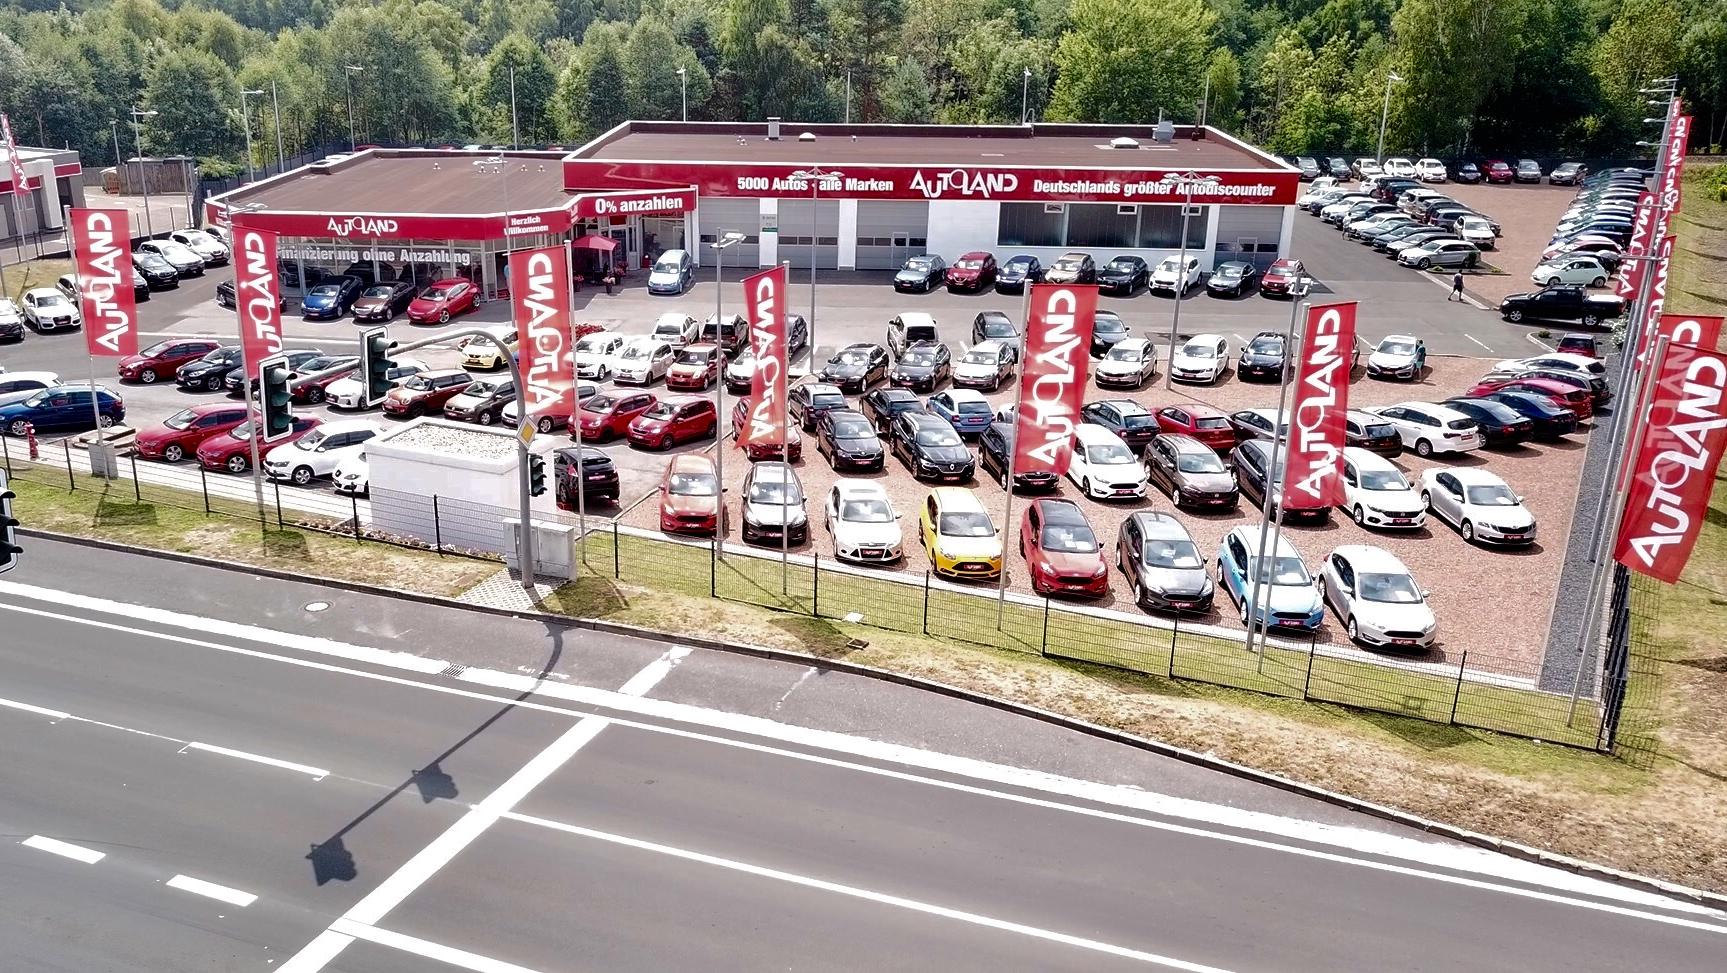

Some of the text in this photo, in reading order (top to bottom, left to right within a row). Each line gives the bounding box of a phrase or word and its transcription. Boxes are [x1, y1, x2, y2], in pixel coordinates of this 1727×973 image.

[737, 177, 769, 191] 5000
[772, 176, 808, 191] Autos
[845, 177, 894, 192] Marken
[909, 168, 1019, 198] AUTOLAND
[1033, 179, 1276, 197] Deutschlands größter Autodiscounter
[595, 196, 683, 214] 0% anzahlen
[327, 216, 398, 237] AUTOLAND
[503, 224, 549, 236] Willkommen
[511, 215, 541, 226] Herzlich
[362, 246, 395, 262] ohne
[400, 248, 471, 266] Anzahlung
[87, 212, 129, 352] AUTOLAND
[244, 231, 283, 363] UTOLAND
[1027, 288, 1082, 466] AUTOLAND
[1294, 308, 1344, 500] AUTOLAND
[1628, 355, 1727, 568] AUTOLAND
